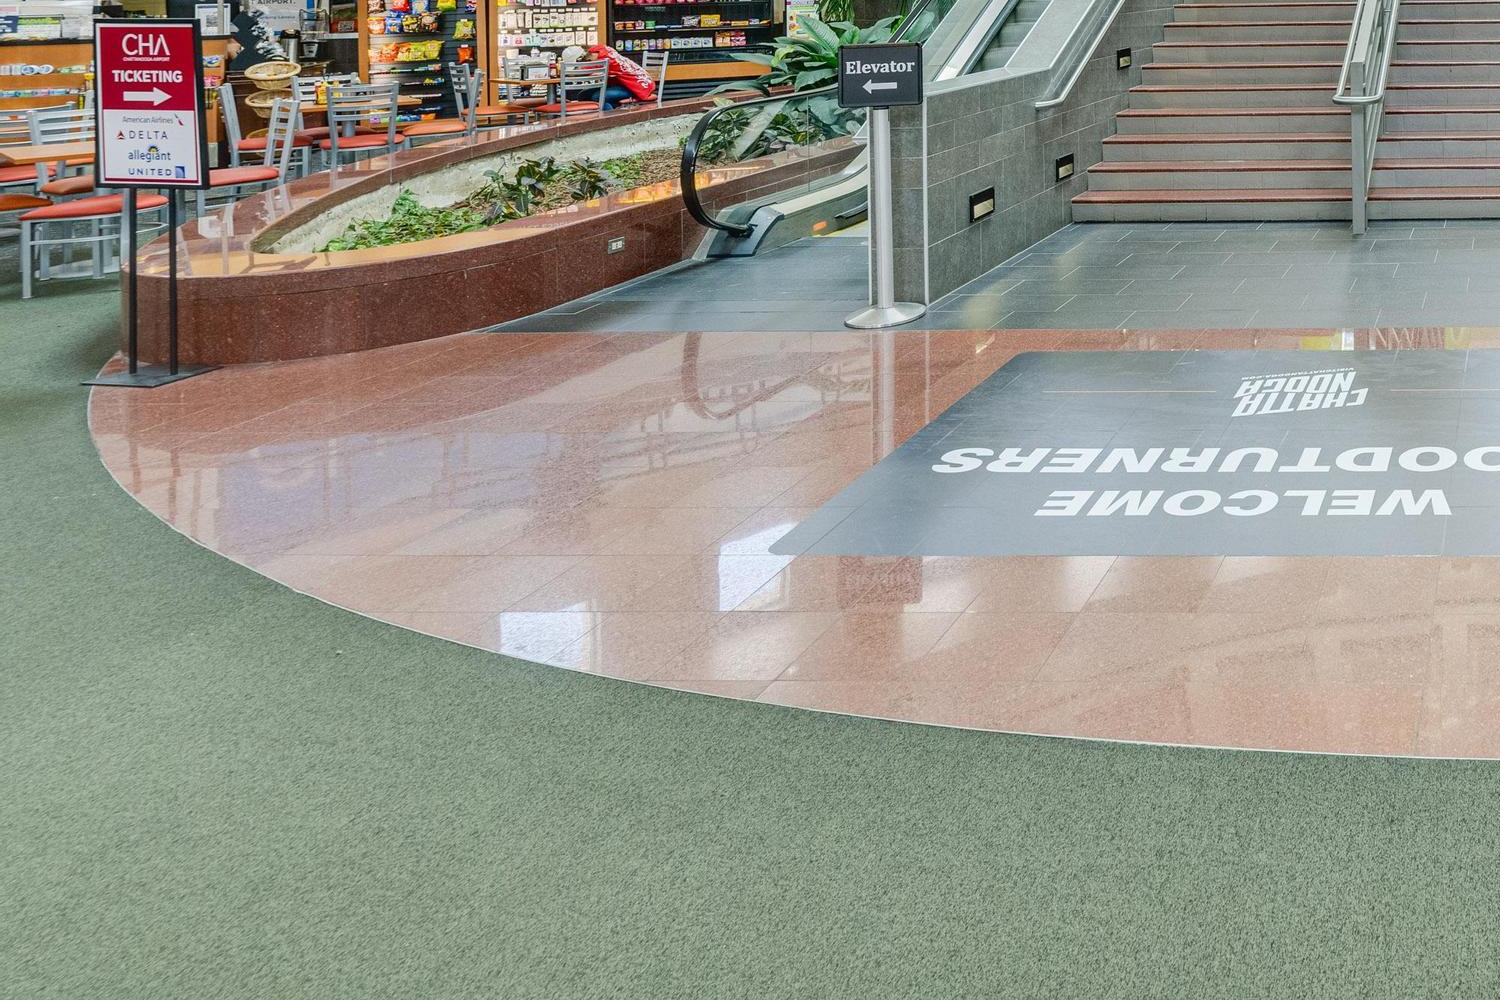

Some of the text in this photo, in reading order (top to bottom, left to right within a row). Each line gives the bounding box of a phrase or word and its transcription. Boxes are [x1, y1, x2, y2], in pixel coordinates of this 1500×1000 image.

[121, 33, 171, 56] CHA
[845, 60, 916, 75] Elevator
[111, 69, 184, 83] TICKETING
[122, 115, 174, 125] American Airlines
[128, 130, 169, 140] DELTA
[128, 150, 172, 163] allegiant
[128, 167, 173, 176] UNITED
[1233, 371, 1357, 399] NOOGA
[1231, 387, 1369, 418] CHATTA
[1034, 488, 1453, 518] WELCOME
